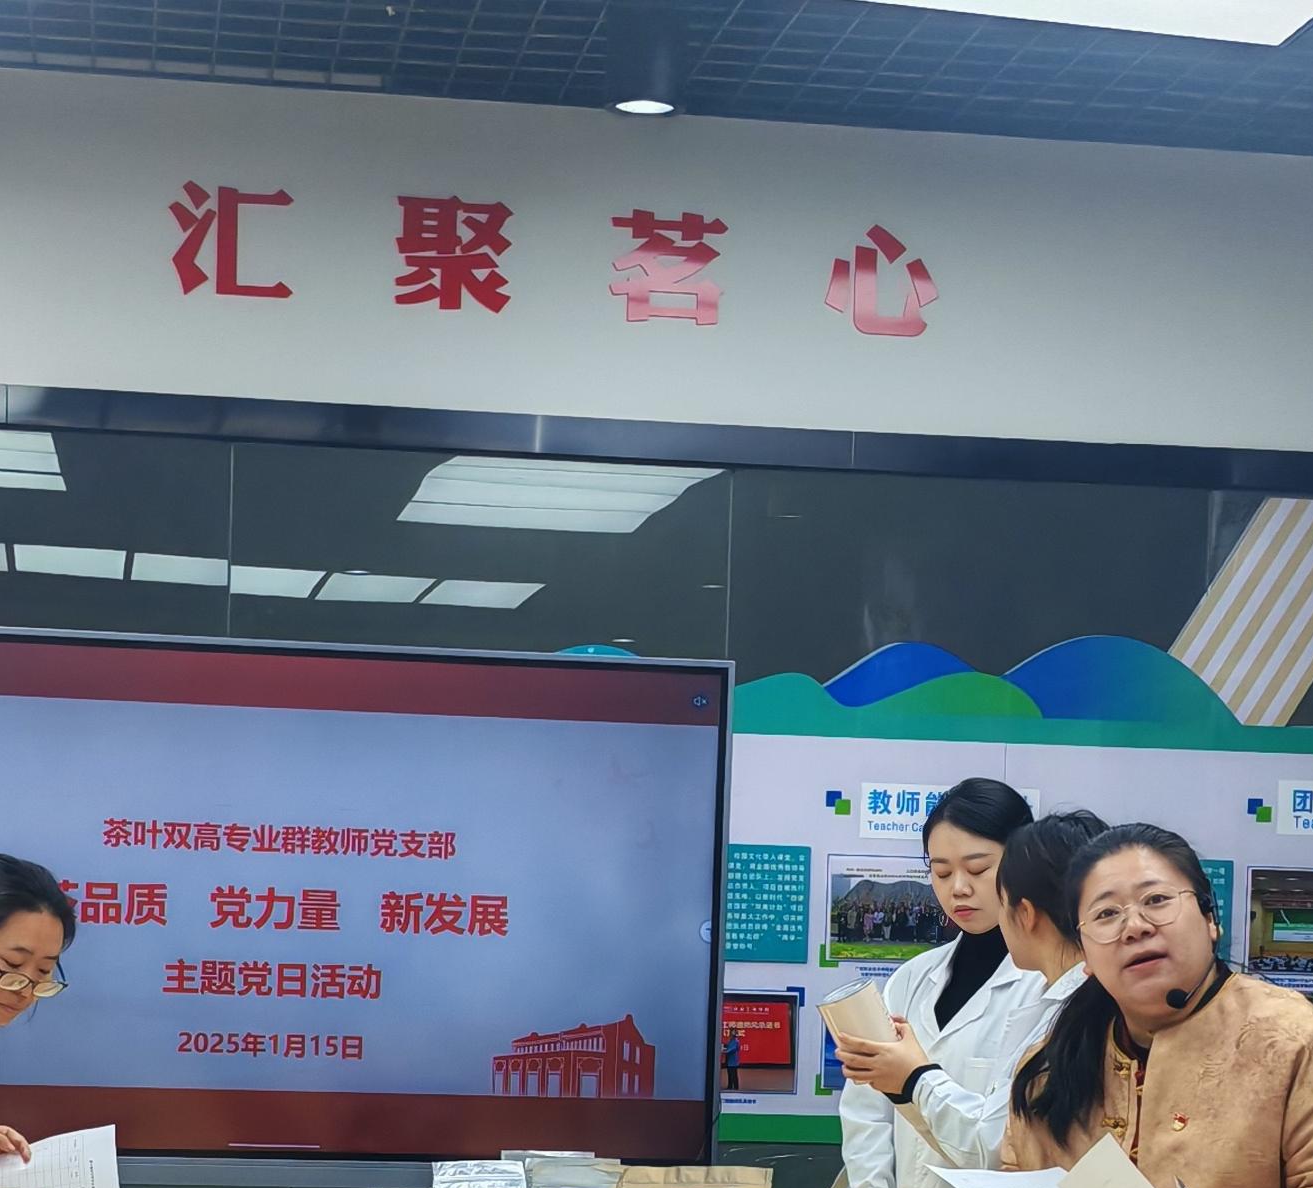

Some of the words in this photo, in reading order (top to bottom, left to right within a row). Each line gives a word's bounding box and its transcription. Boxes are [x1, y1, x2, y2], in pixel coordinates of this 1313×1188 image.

[167, 180, 939, 338] 汇聚茗心
[102, 818, 456, 860] 茶叶双高专业群教师党支部
[867, 820, 909, 832] Teacher
[209, 885, 341, 932] 党力量
[380, 891, 509, 937] 新发展
[162, 958, 382, 1000] 主题党日活动
[177, 1032, 364, 1060] 2025年1月15日
